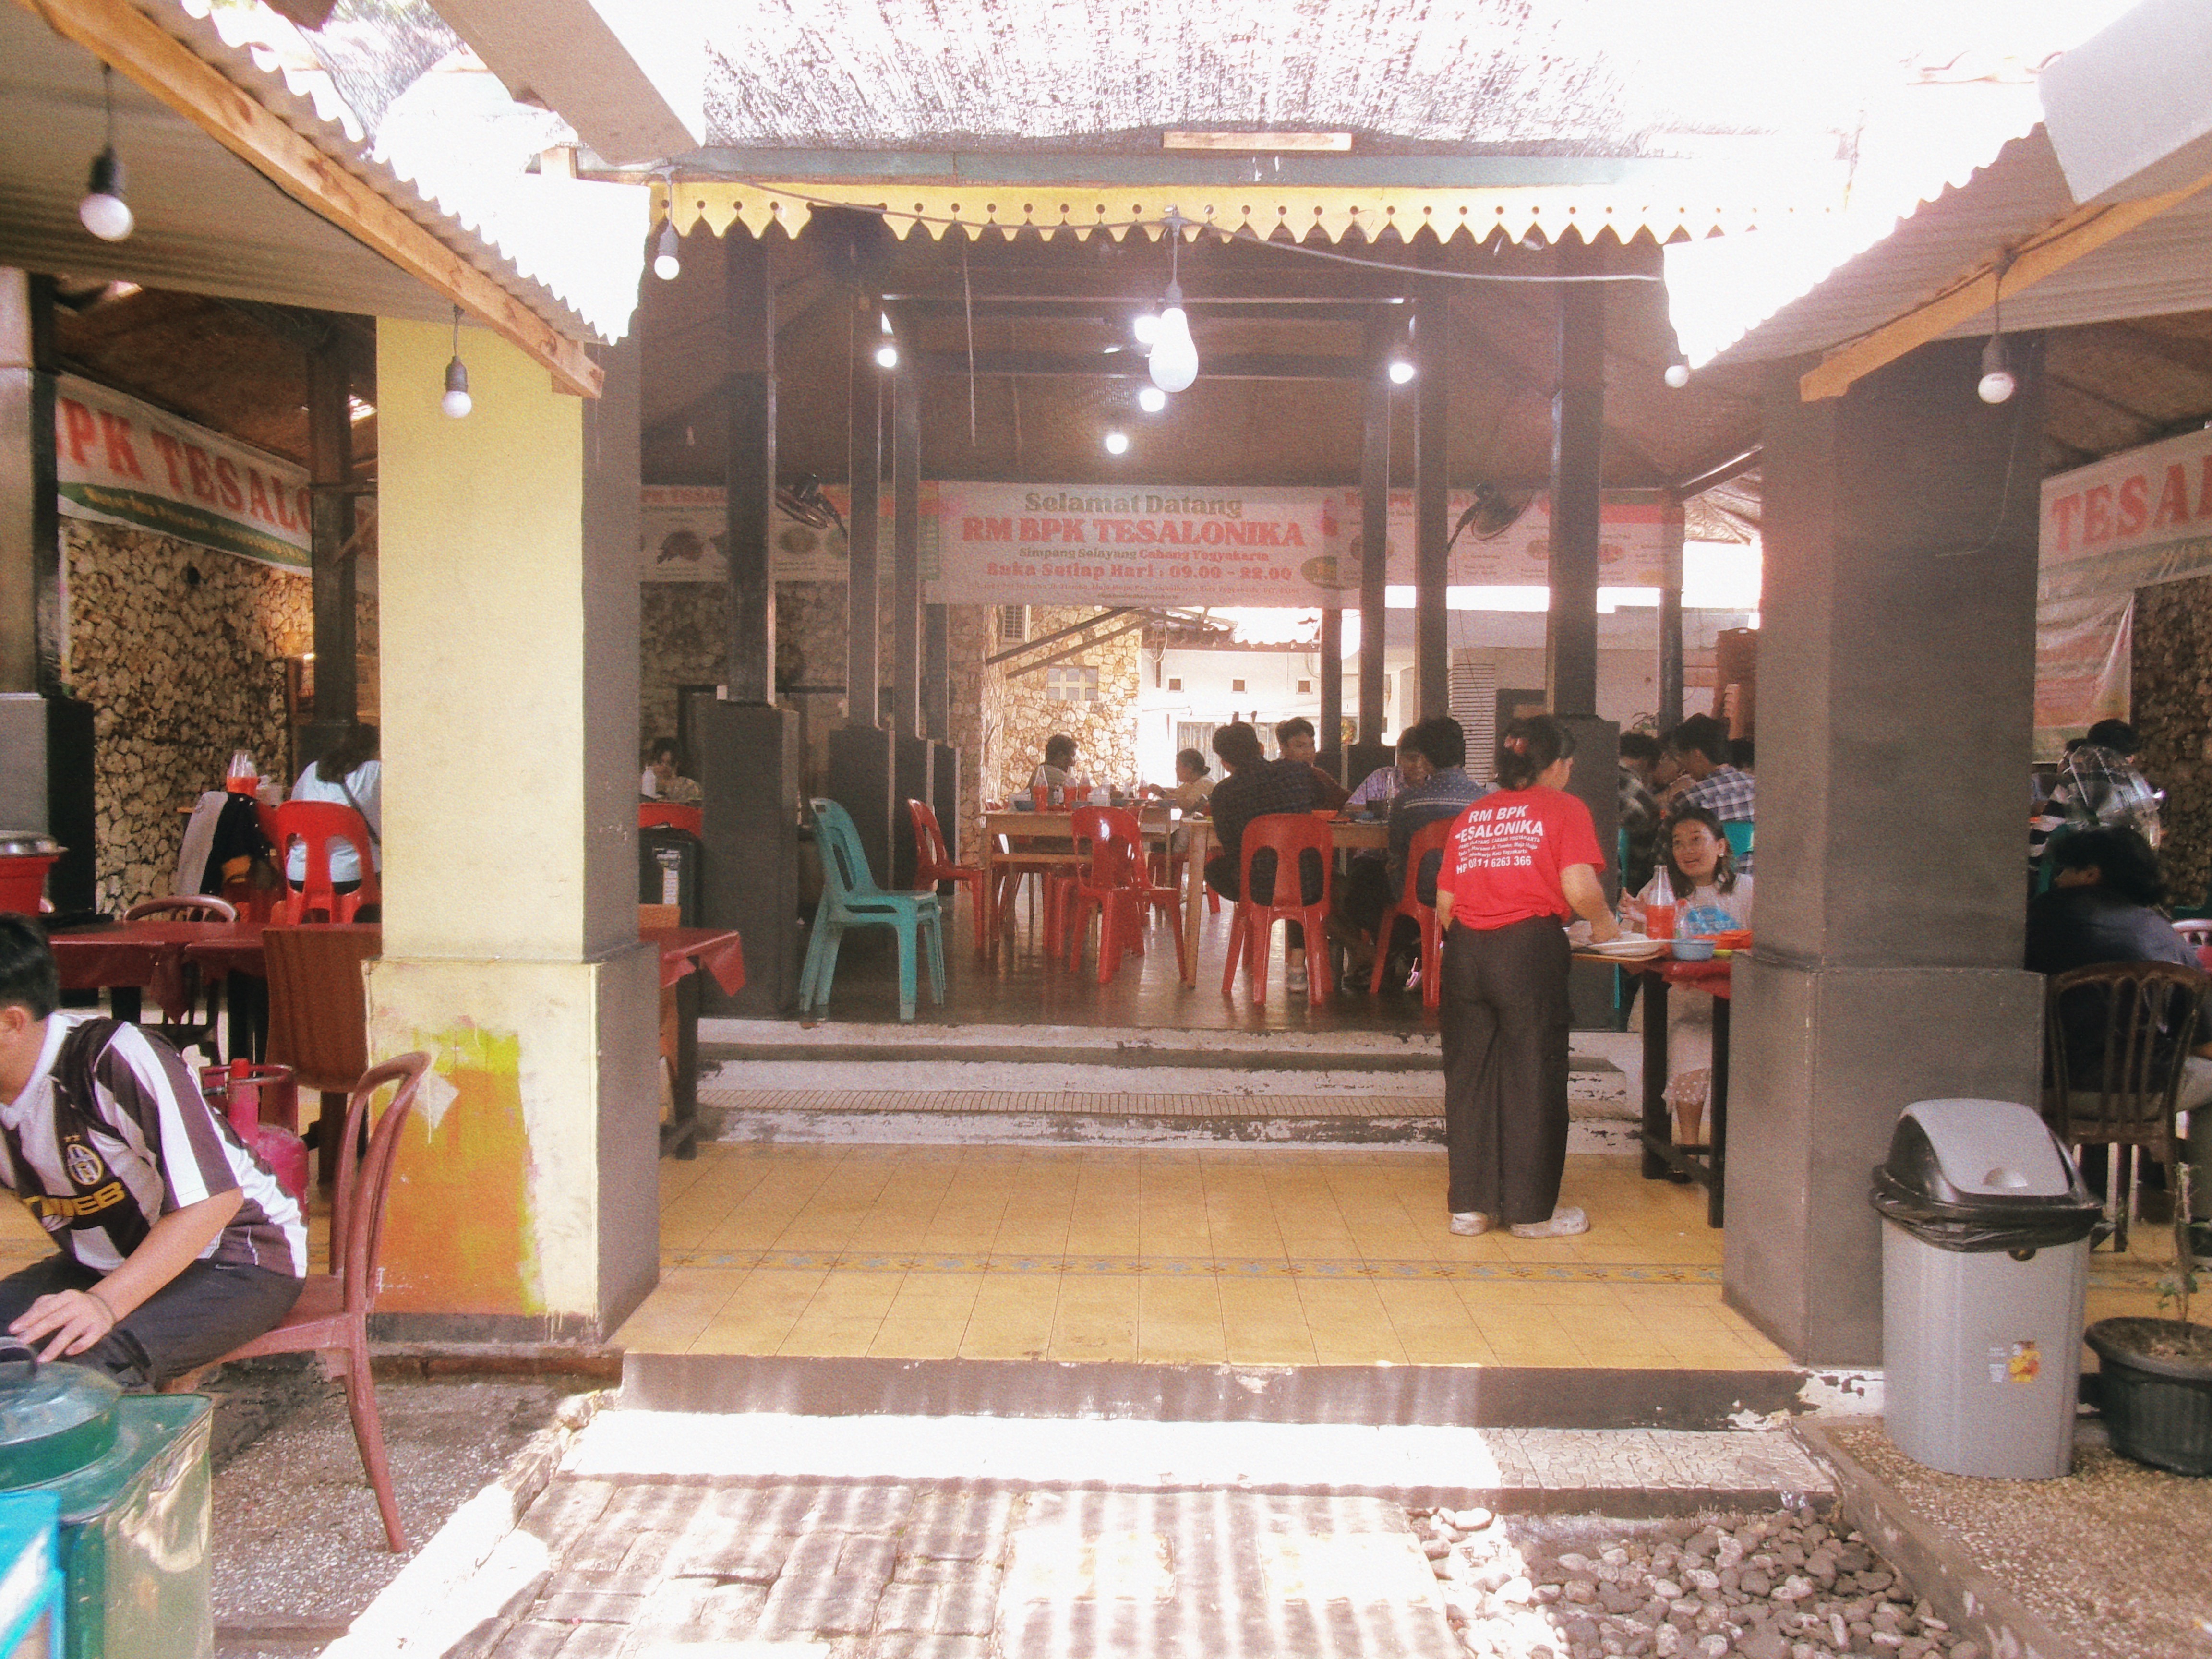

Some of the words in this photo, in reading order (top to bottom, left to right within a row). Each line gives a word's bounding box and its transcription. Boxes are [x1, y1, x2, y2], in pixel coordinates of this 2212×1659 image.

[56, 397, 144, 481] PK
[1025, 492, 1140, 513] Selamat
[1145, 495, 1243, 518] Datang
[962, 517, 1012, 542] RM
[1018, 518, 1086, 543] BPK
[1093, 519, 1306, 546] TESALONIKA
[1019, 547, 1076, 560] Simpang
[1139, 548, 1190, 562] Cabang
[1192, 549, 1269, 563] Yogyakarta
[987, 561, 1036, 576] Buka
[1042, 562, 1105, 581] Setiap
[1110, 564, 1153, 577] Hari
[1168, 565, 1223, 579] 09.00
[1468, 809, 1493, 823] RM
[1496, 805, 1529, 821] BPK
[1456, 863, 1467, 874] HP
[1468, 857, 1489, 869] 0811
[1491, 856, 1511, 867] 6263
[1514, 855, 1532, 866] 366
